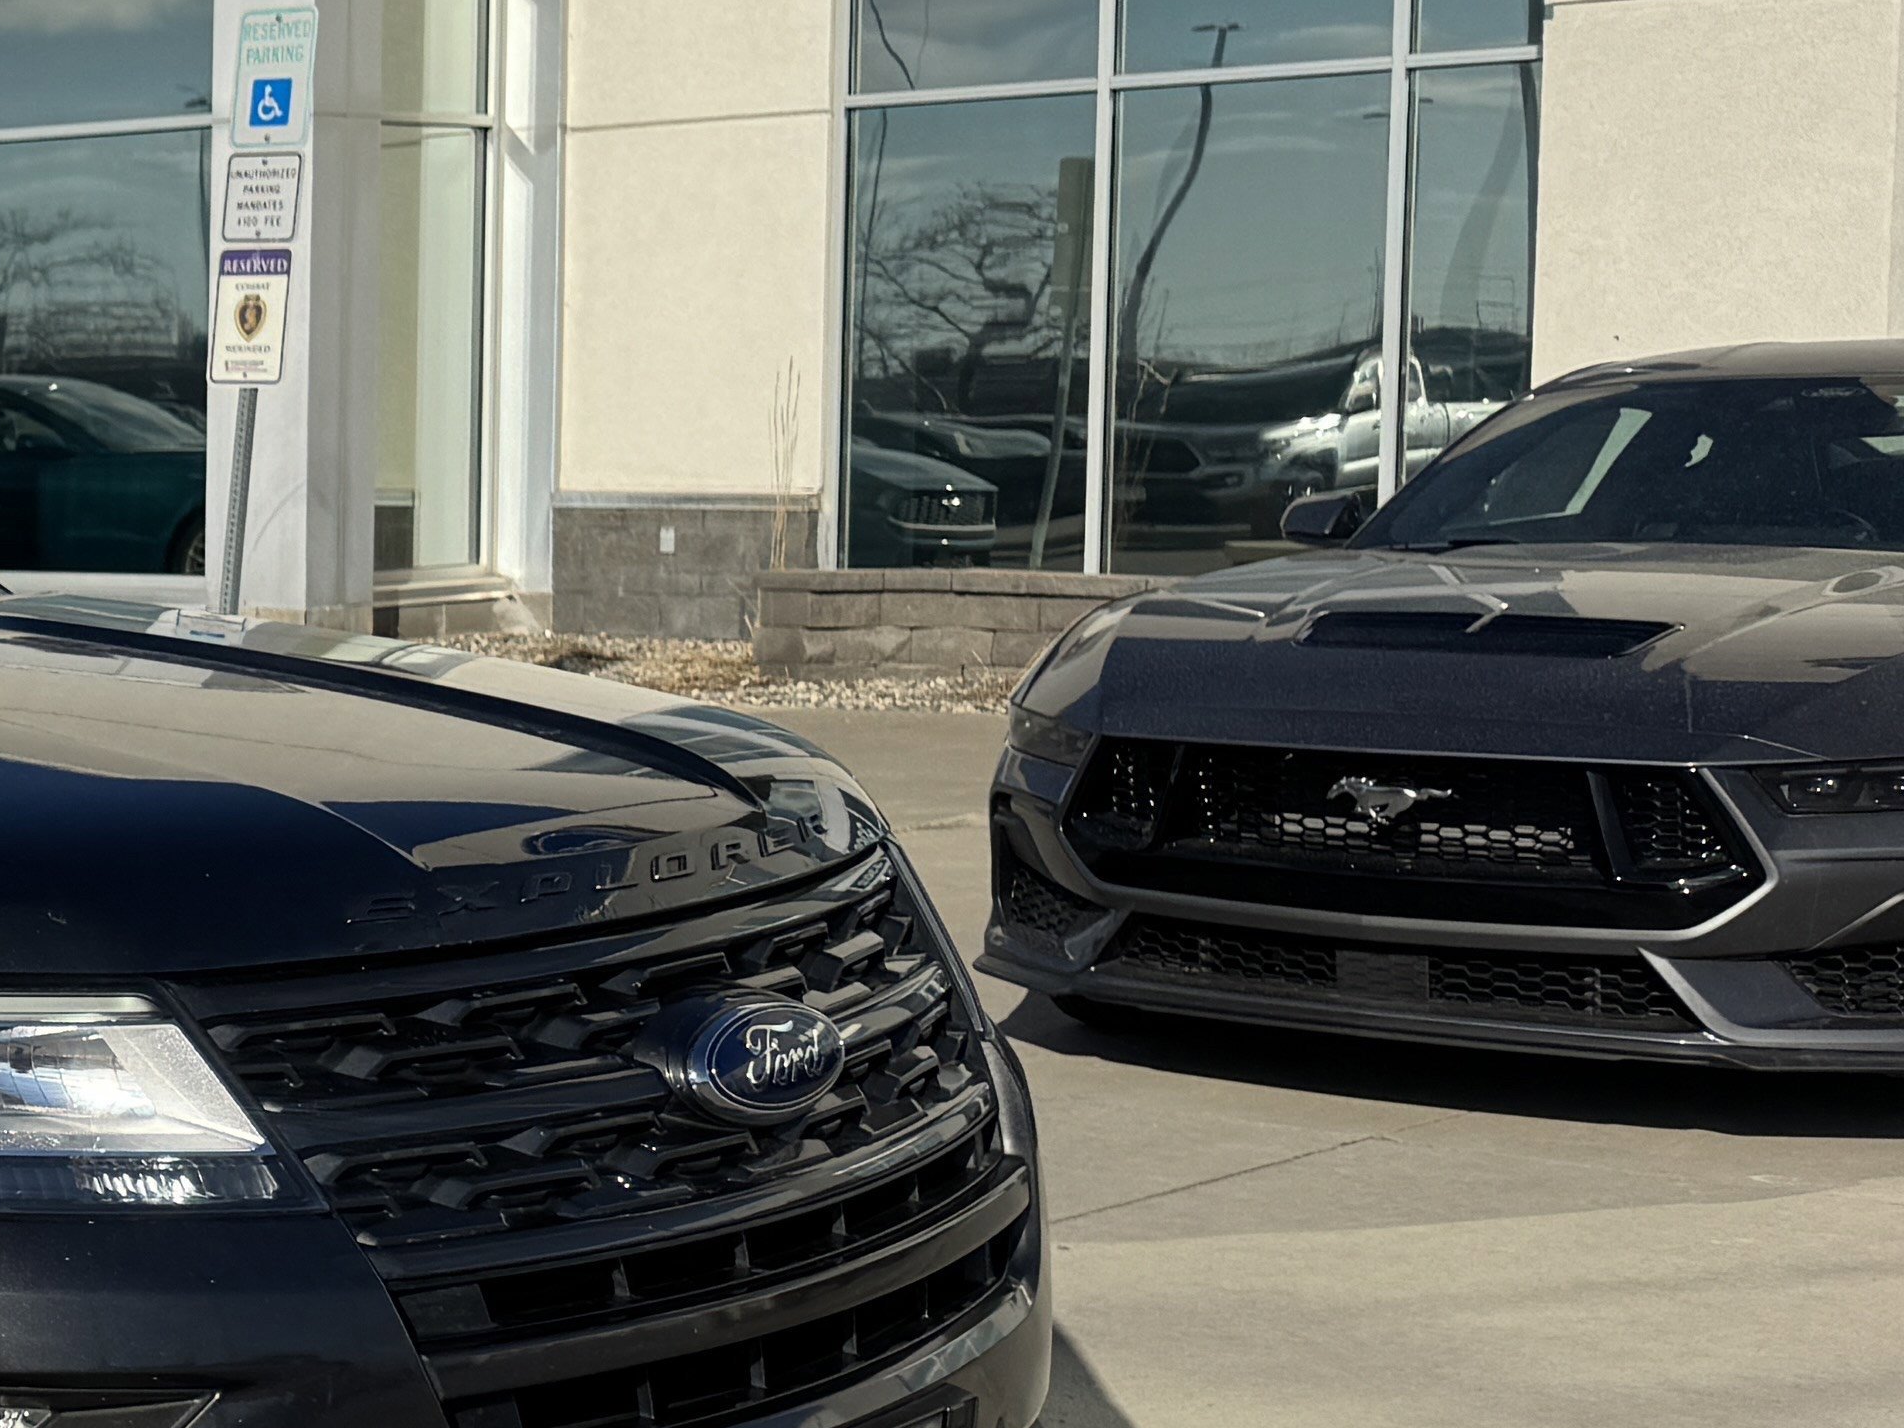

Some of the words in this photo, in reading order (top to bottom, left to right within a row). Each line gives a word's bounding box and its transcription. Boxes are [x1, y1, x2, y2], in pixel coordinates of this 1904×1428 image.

[243, 20, 311, 42] RESERVED
[246, 44, 304, 66] PARKING
[230, 167, 296, 181] UNAUTHORIZED
[242, 184, 281, 195] PARKING
[236, 199, 284, 212] MANDATES
[264, 214, 282, 228] FEE
[223, 257, 288, 274] RESERVED
[345, 814, 826, 925] EXPLORER
[745, 1020, 826, 1093] Ford
